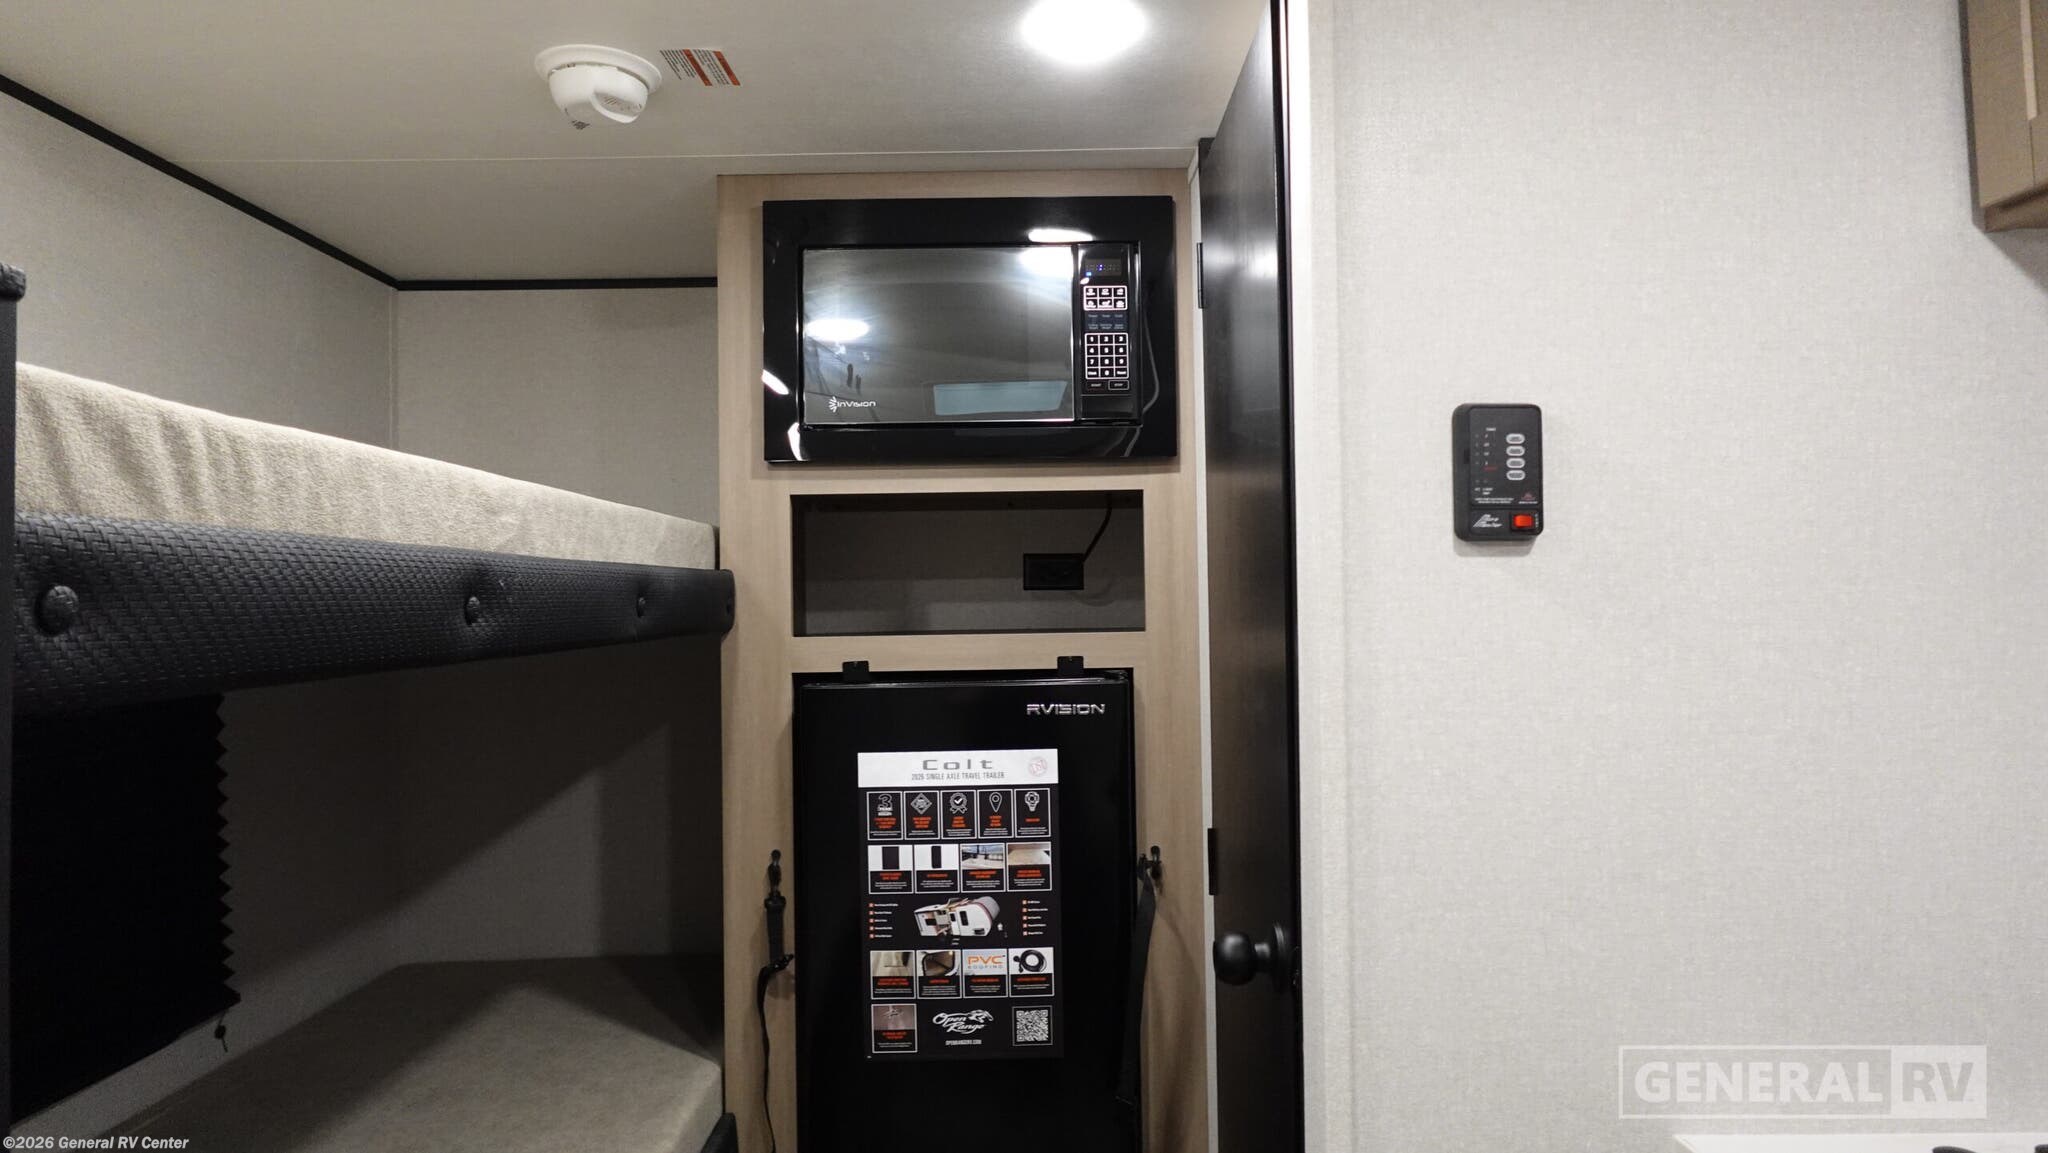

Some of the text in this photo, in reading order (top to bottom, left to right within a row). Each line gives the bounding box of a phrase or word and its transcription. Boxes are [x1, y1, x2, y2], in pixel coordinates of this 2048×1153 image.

[1026, 703, 1106, 715] RVISION
[922, 758, 993, 770] Colt
[983, 771, 1005, 779] TRAILER
[967, 955, 1003, 964] PVC
